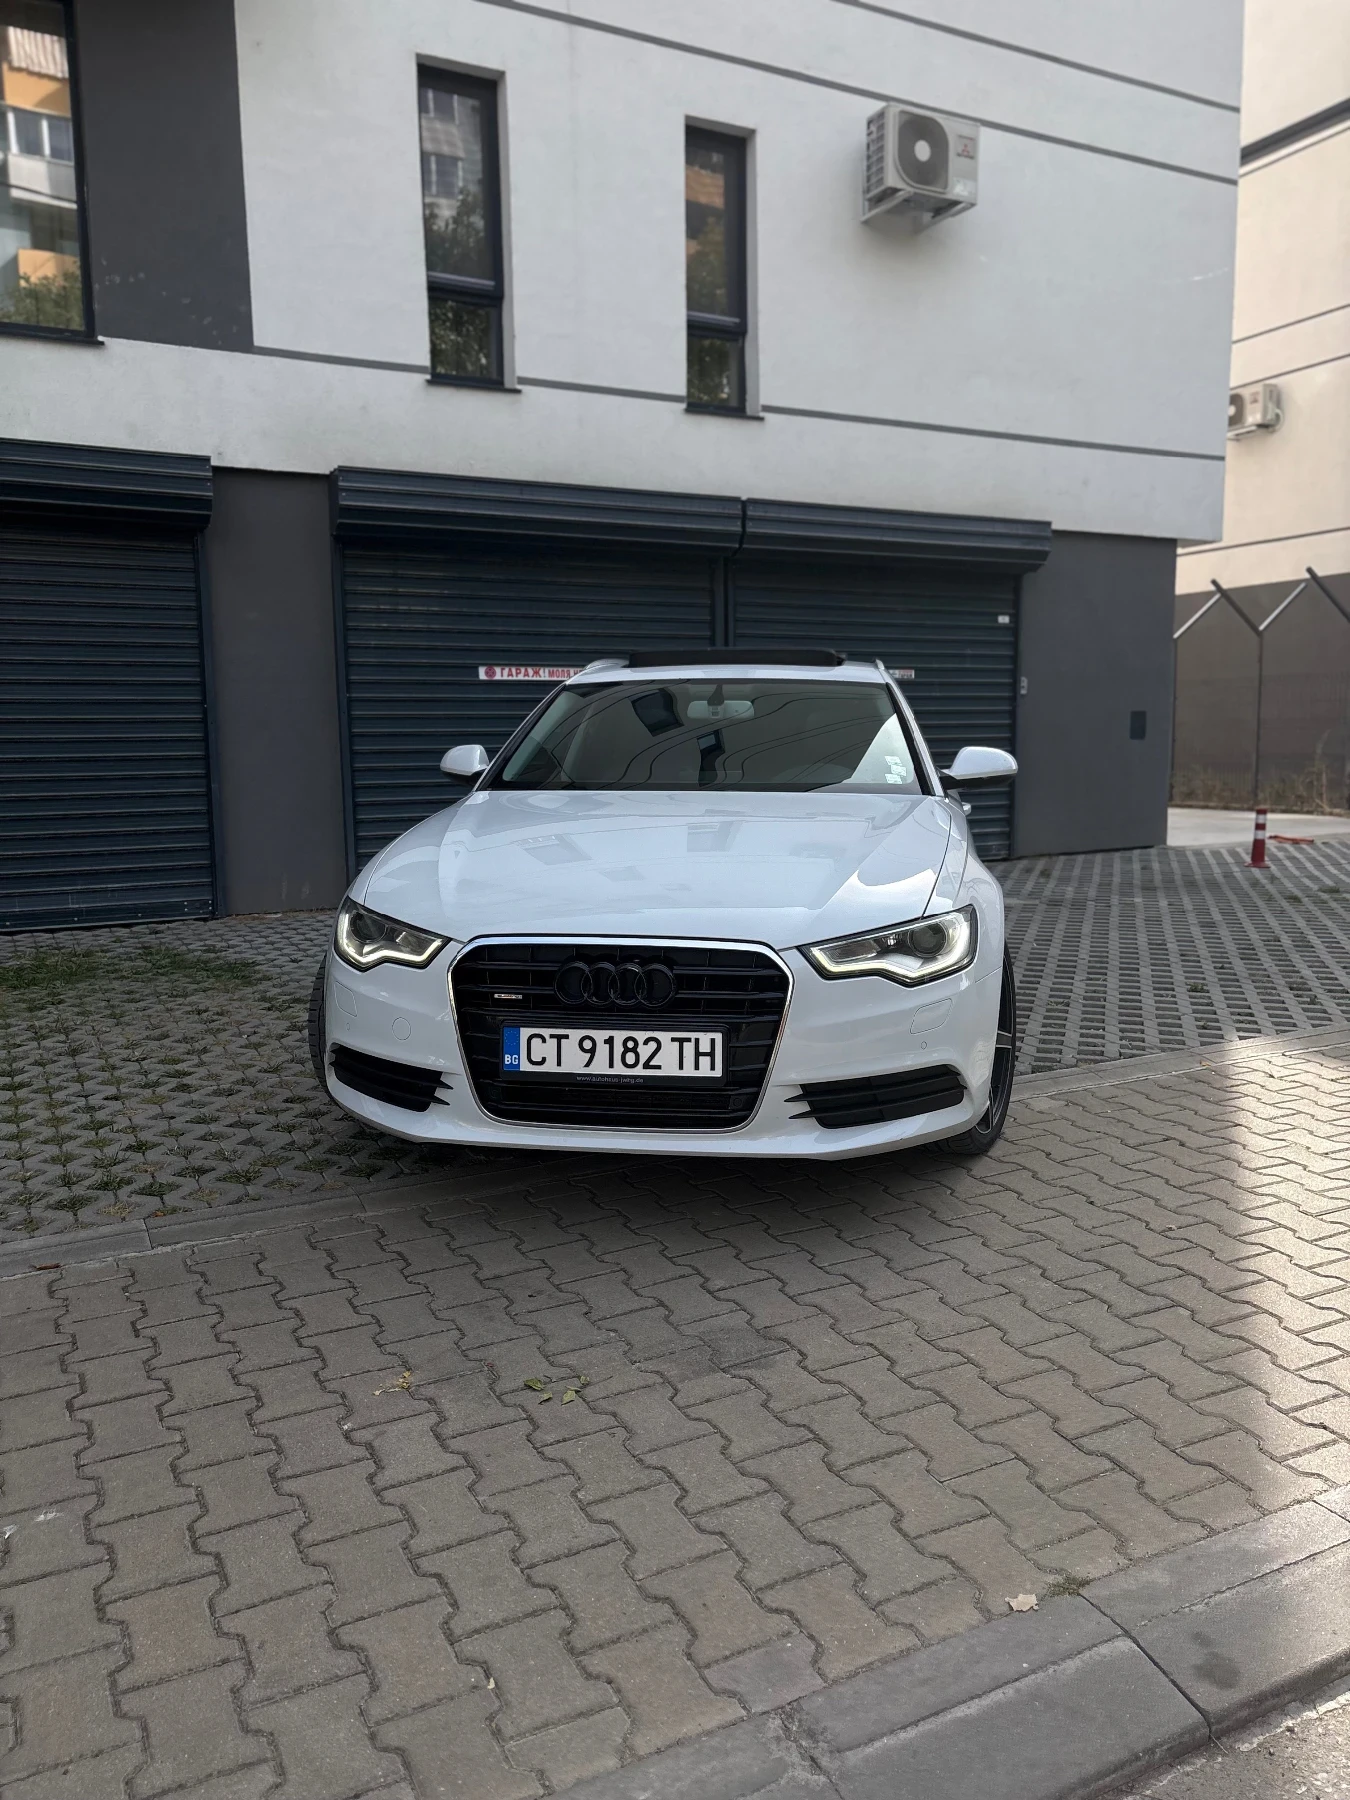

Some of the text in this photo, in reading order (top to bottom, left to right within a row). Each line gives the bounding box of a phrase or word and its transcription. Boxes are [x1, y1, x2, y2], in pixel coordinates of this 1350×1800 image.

[504, 1054, 519, 1065] BG
[526, 1033, 716, 1072] CT 9182 TH
